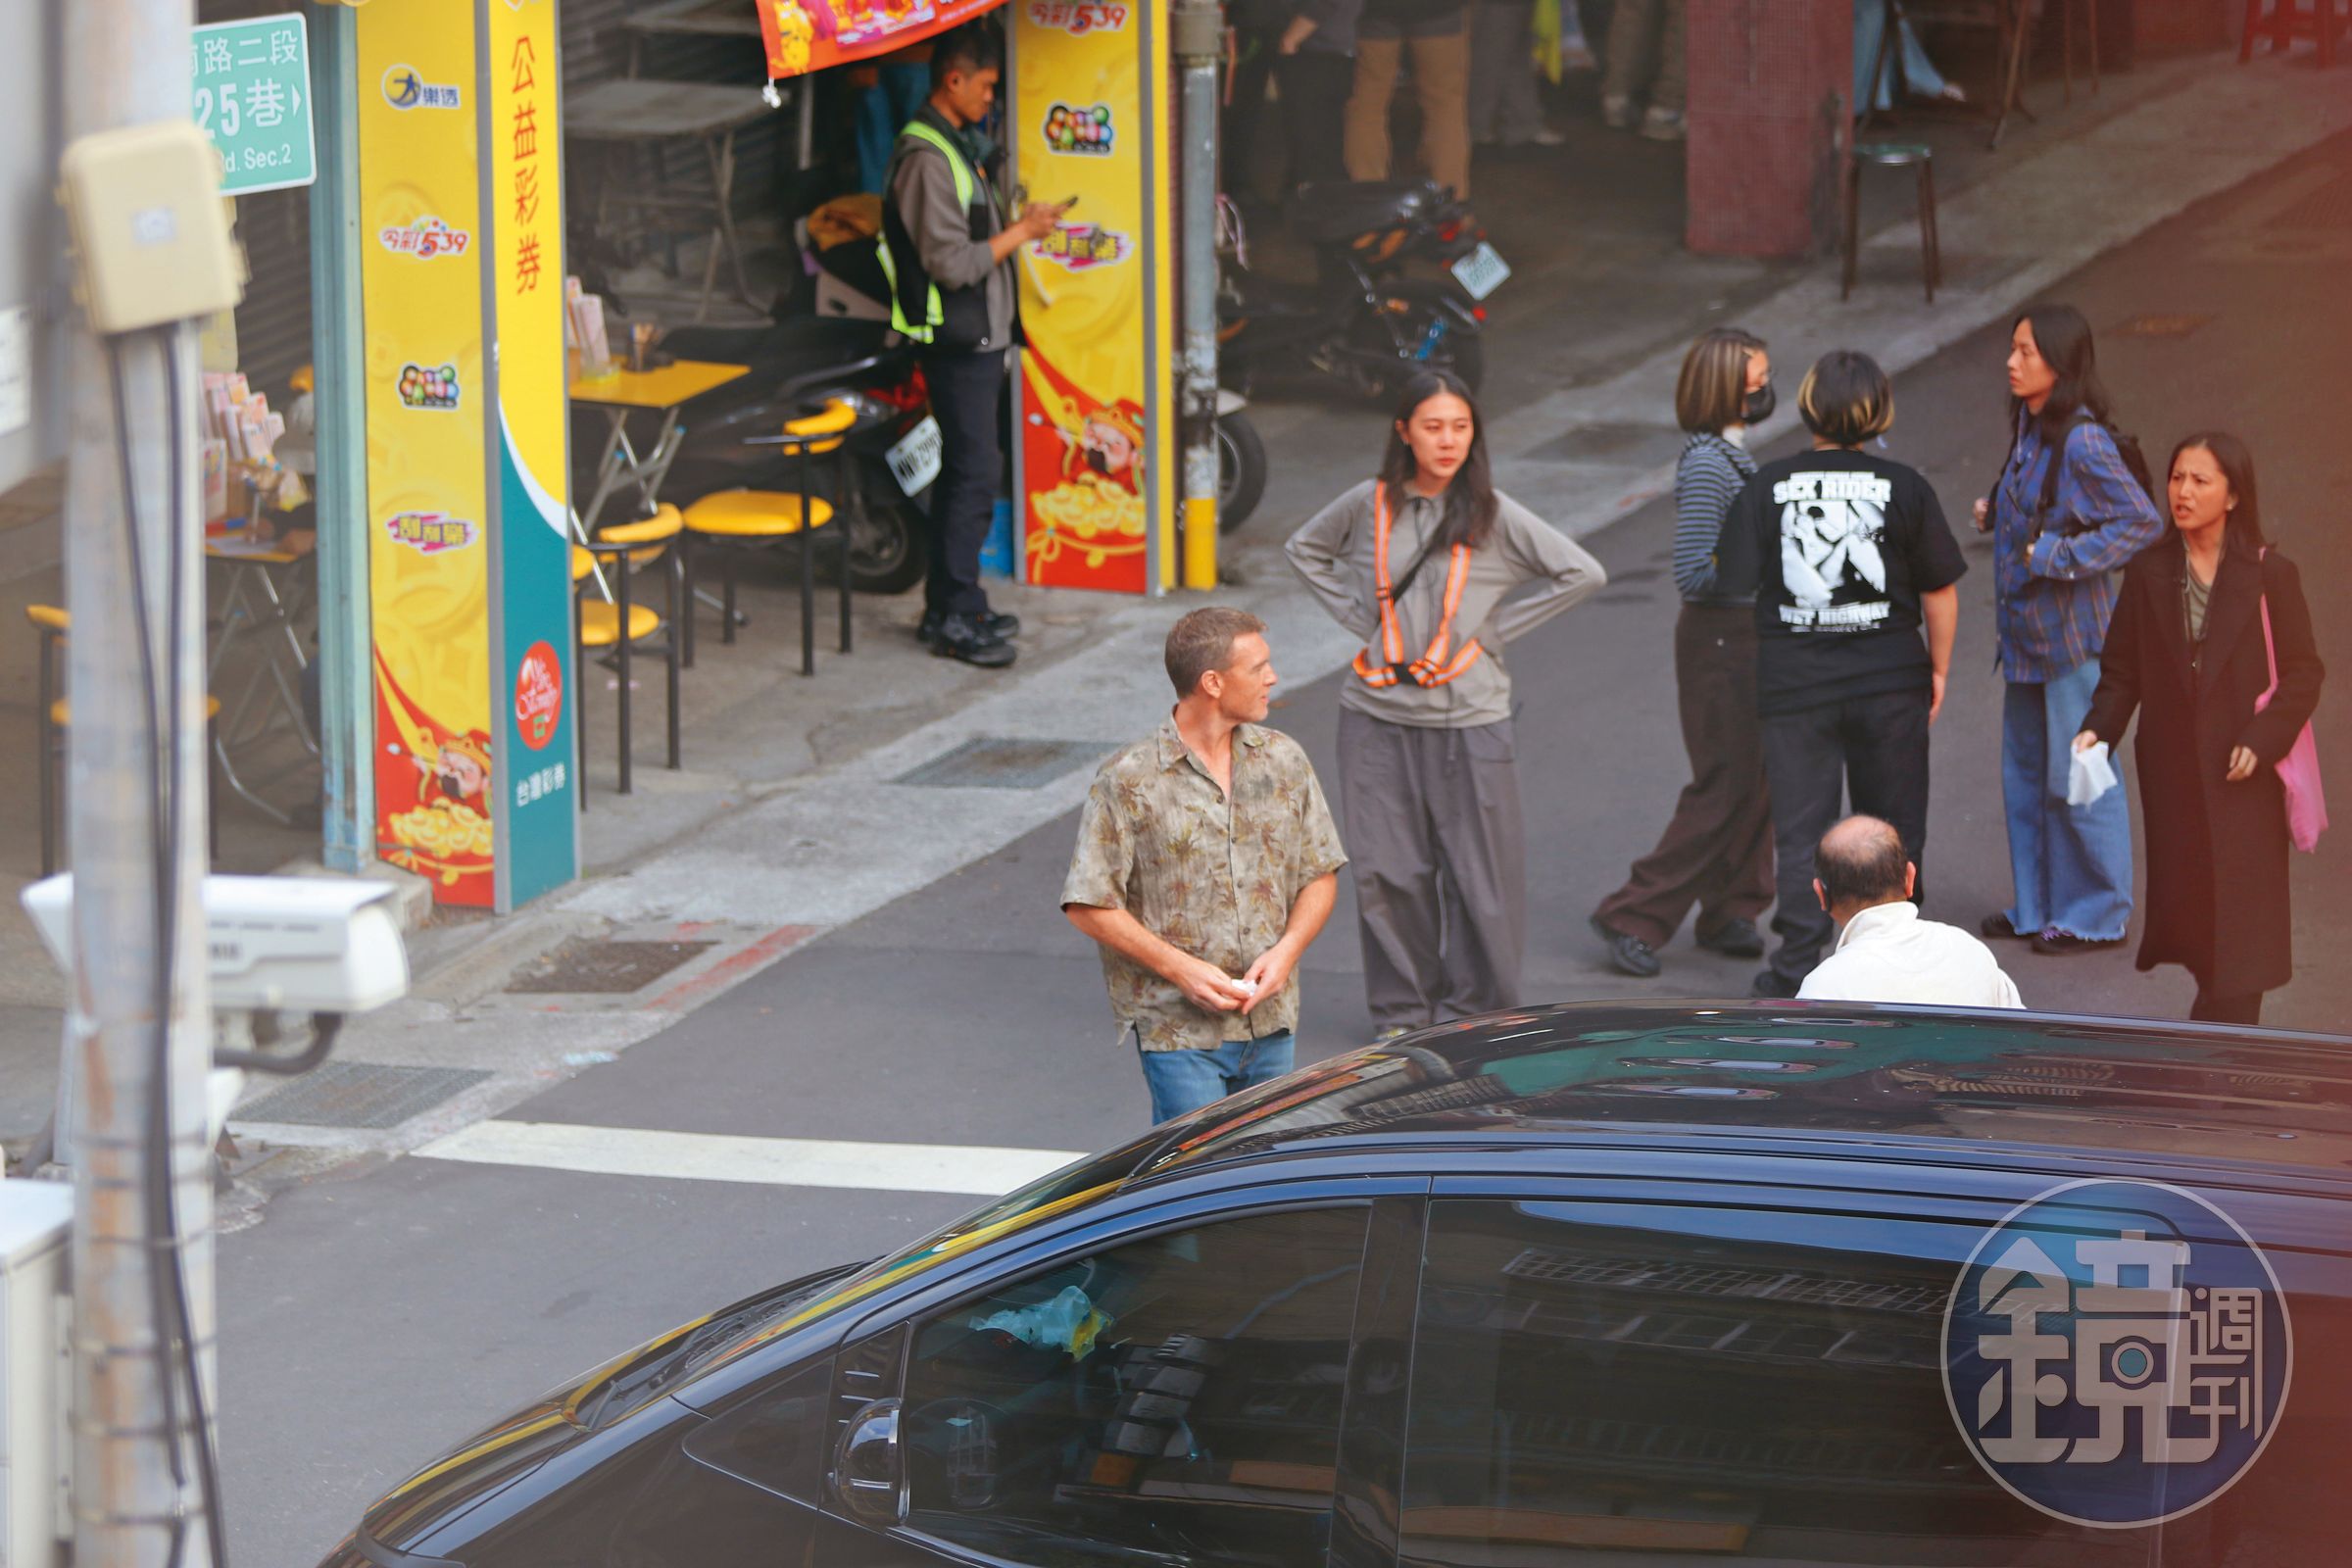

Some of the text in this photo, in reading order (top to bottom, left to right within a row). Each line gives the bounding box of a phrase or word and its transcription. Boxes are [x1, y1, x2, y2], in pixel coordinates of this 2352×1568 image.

[191, 29, 298, 76] 路二段
[220, 143, 292, 172] d. Sec.2
[513, 35, 540, 295] 公益彩券
[1773, 477, 1891, 504] SEX RIDER
[1779, 604, 1816, 626] WET
[1818, 601, 1891, 627] HIGHWAY
